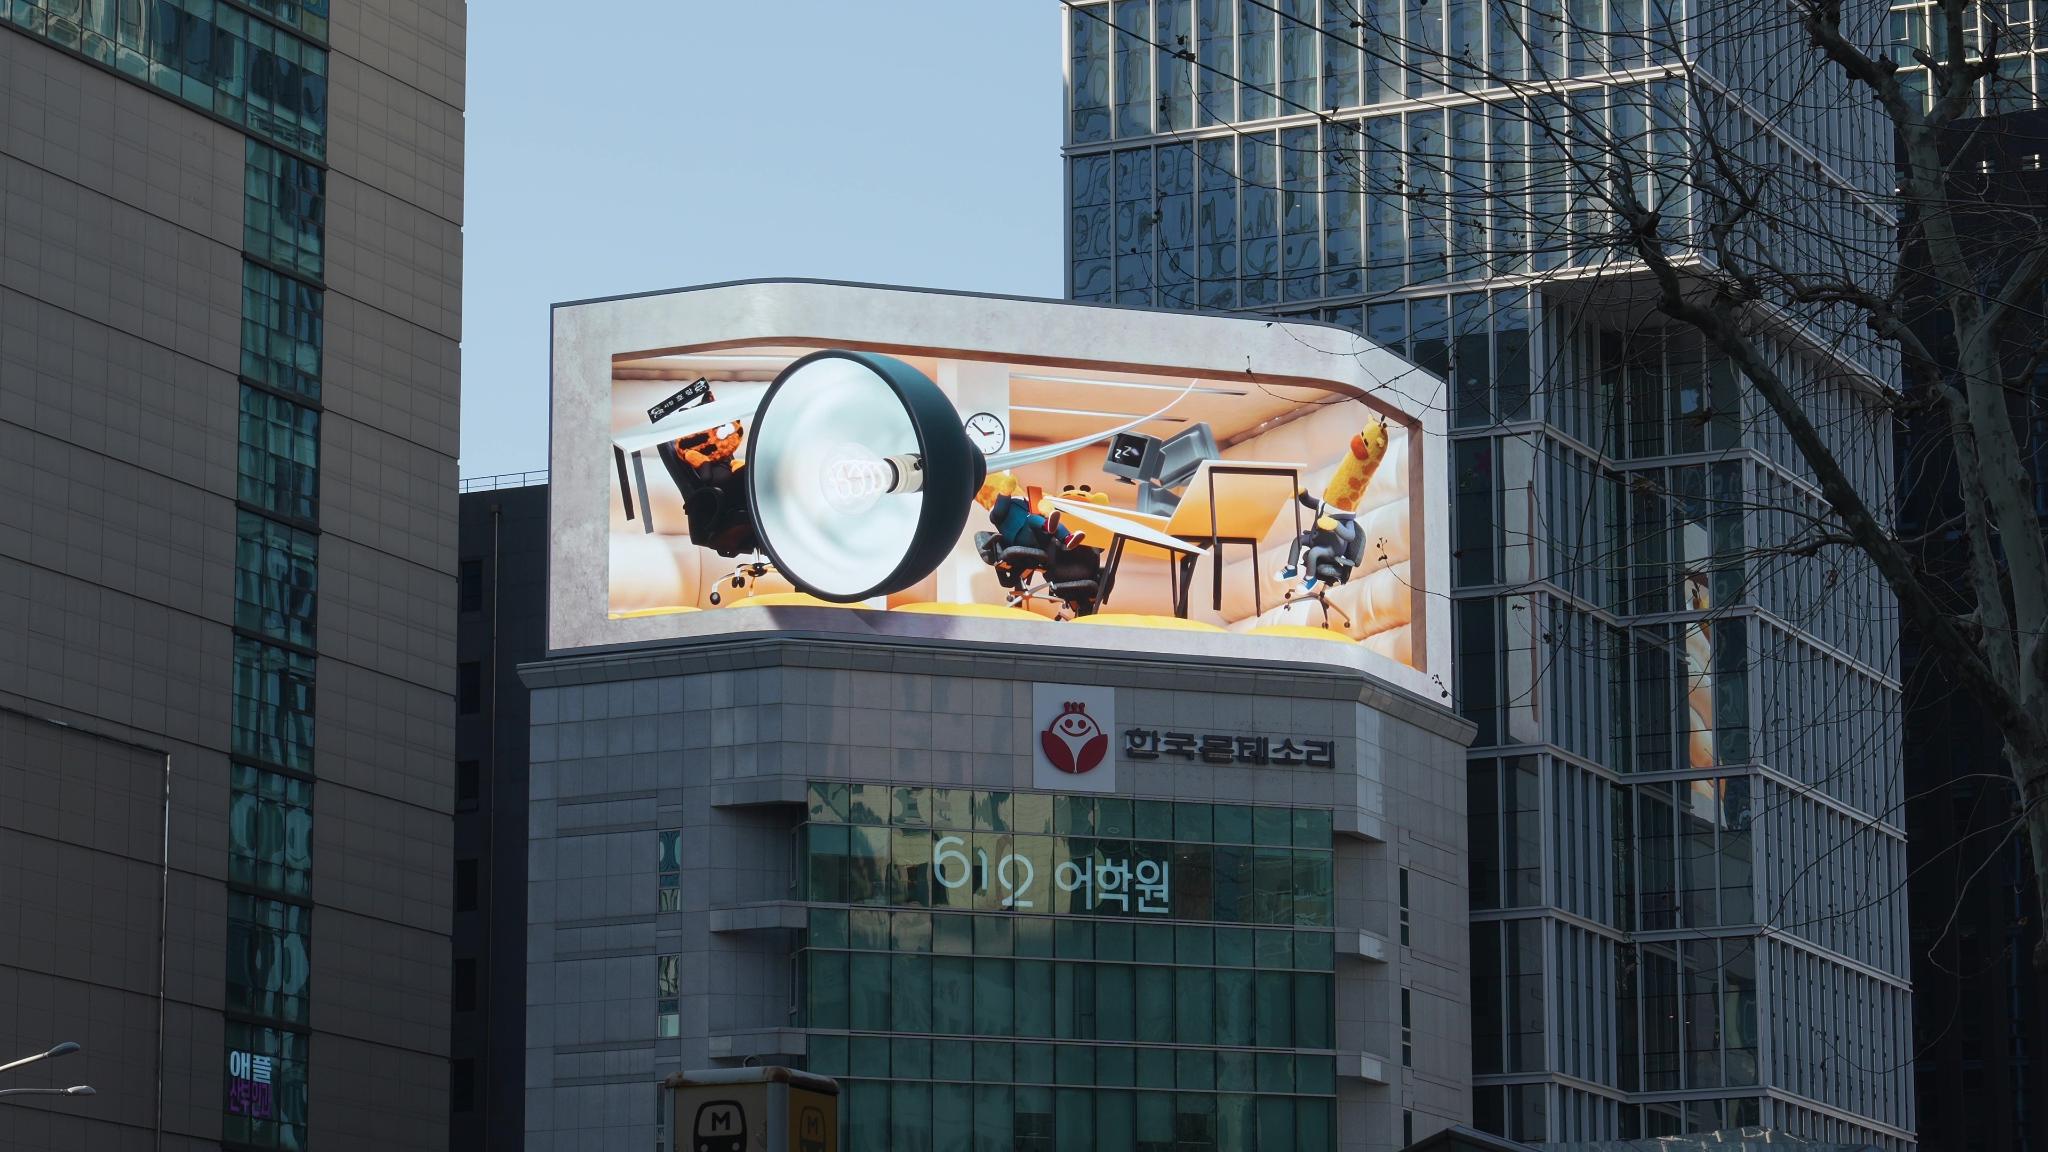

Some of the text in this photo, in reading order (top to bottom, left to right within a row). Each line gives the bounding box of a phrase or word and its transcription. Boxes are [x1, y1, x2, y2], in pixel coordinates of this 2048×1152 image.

[1125, 728, 1336, 769] 한국몬테소리
[1054, 856, 1169, 913] 어학원
[230, 1050, 272, 1085] 애플
[711, 1111, 731, 1131] M
